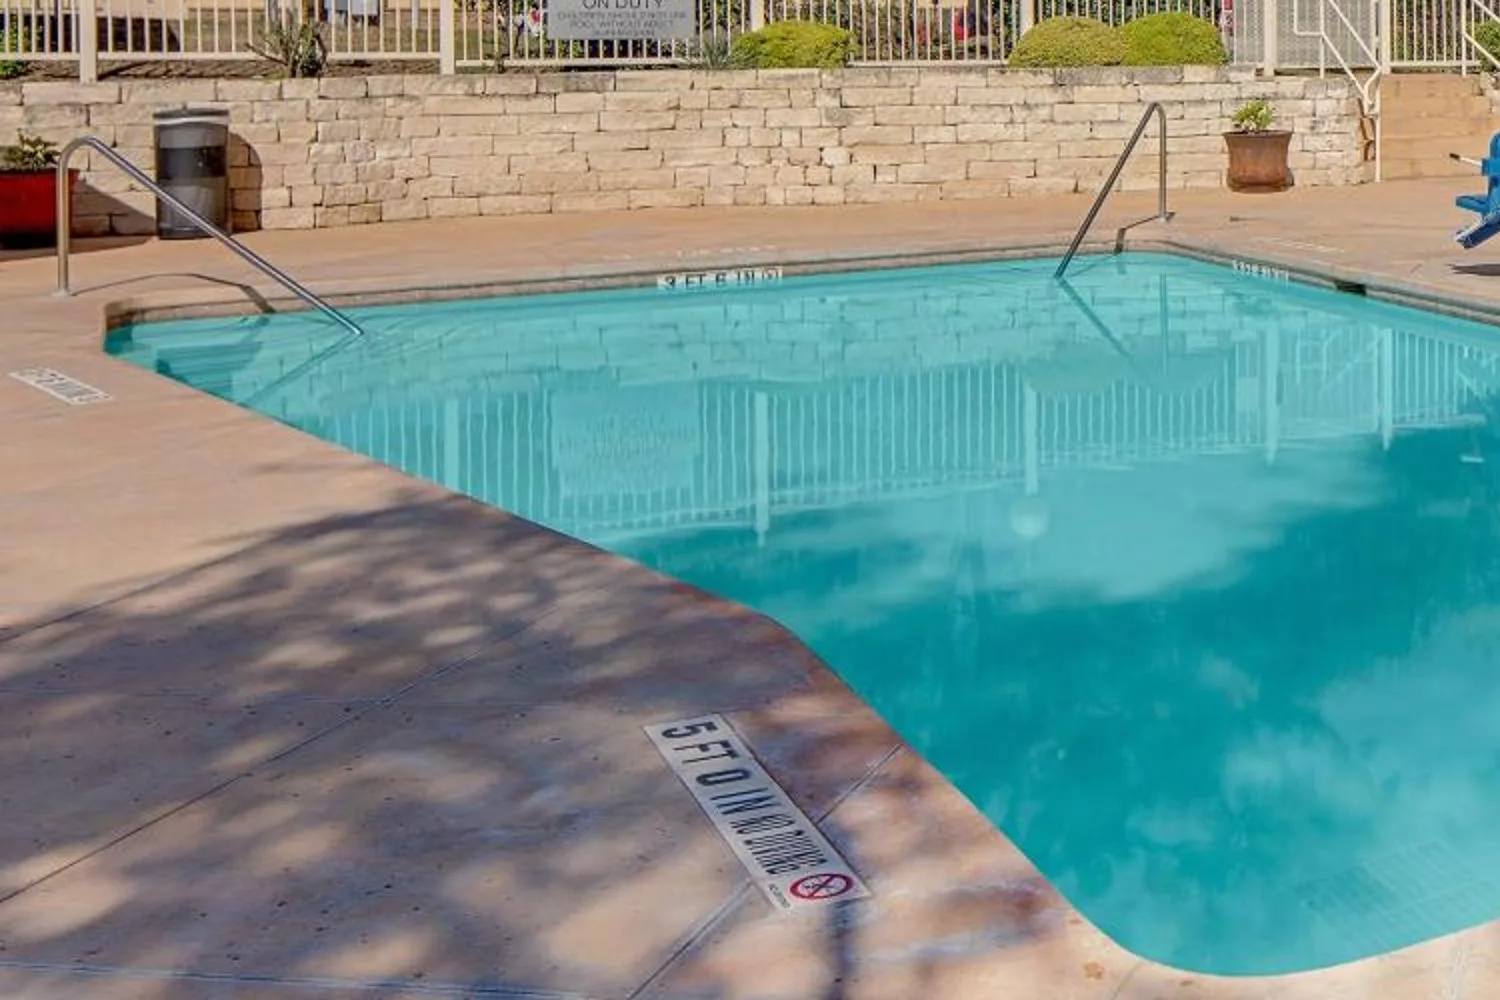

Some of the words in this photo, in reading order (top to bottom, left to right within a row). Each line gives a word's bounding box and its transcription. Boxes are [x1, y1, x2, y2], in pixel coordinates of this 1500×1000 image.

[661, 721, 718, 739] 5
[672, 739, 740, 764] FT
[709, 786, 781, 815] IN
